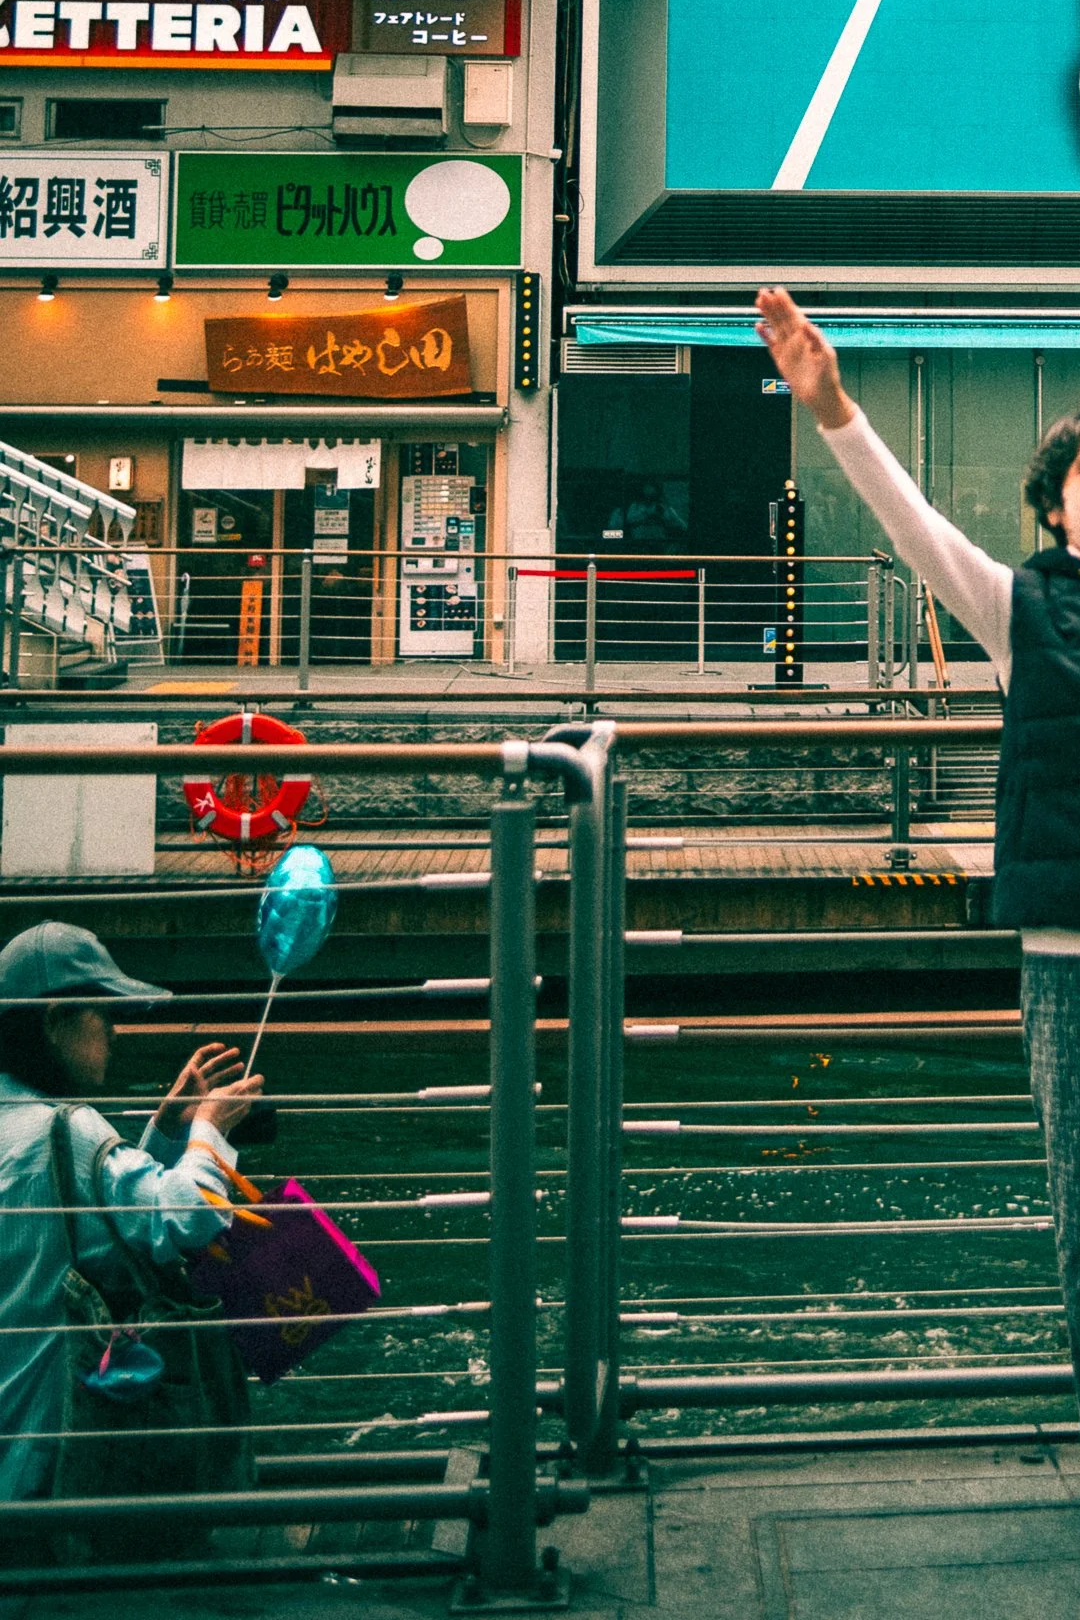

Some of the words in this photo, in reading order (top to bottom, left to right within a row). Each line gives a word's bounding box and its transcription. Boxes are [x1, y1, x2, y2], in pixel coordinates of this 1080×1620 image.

[373, 11, 467, 26] フェアトレード
[411, 28, 489, 46] コーヒー
[0, 176, 139, 239] 紹興酒
[276, 181, 398, 238] ピタットハウス
